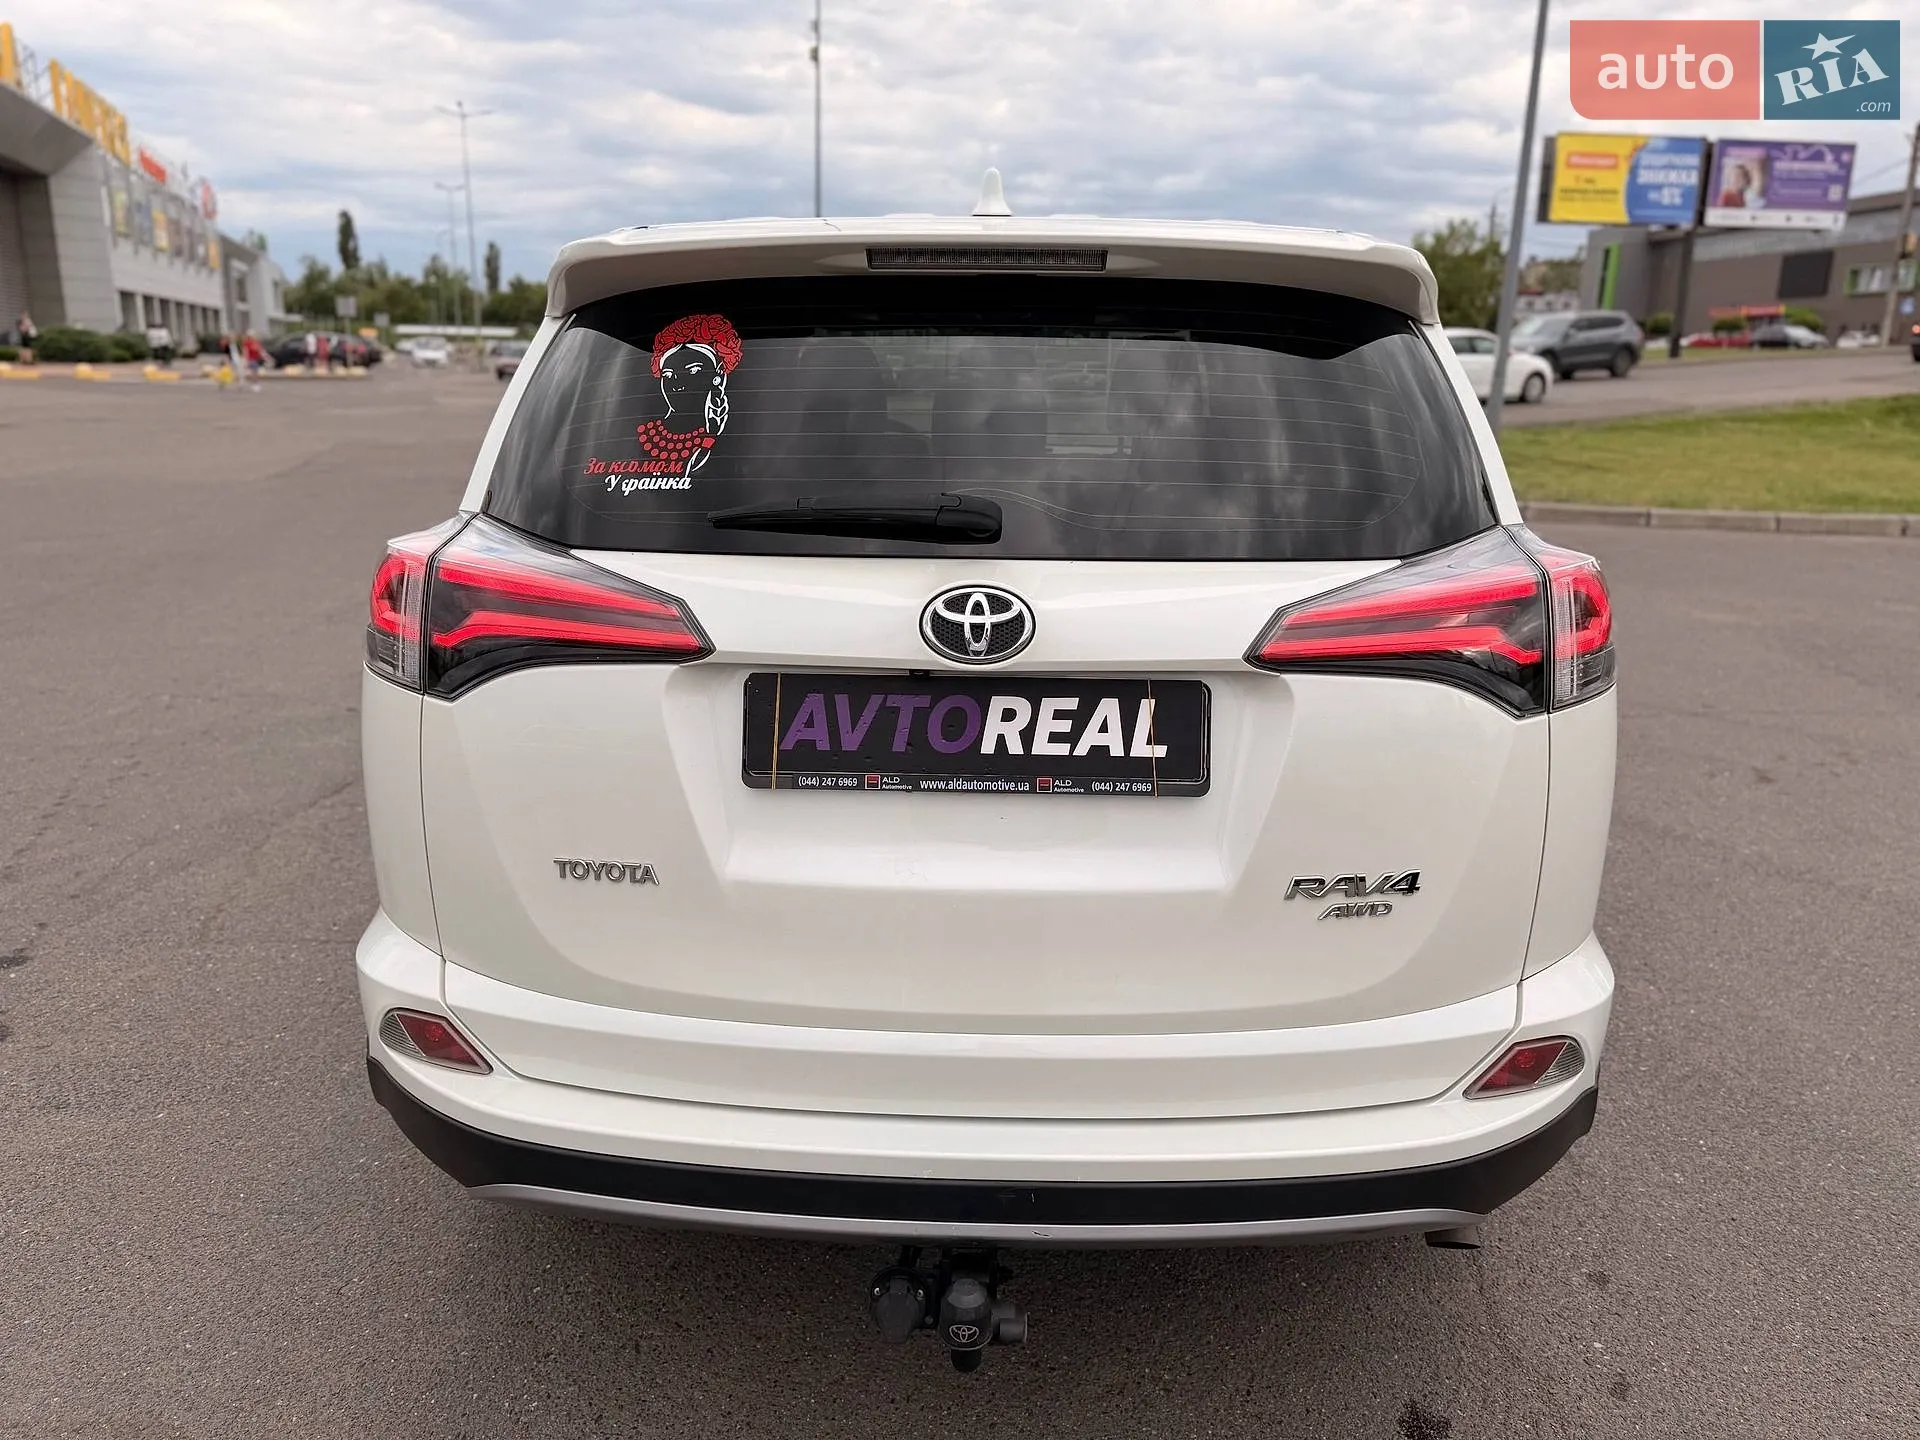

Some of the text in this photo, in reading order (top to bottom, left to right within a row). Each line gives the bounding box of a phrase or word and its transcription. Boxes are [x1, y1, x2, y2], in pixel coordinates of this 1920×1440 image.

[584, 457, 606, 474] За
[780, 694, 1168, 758] AVTOREAL
[798, 776, 858, 787] (044) 247 6969
[920, 778, 1030, 791] www.aldautomotive.ua
[1091, 781, 1152, 792] (044) 247 6969
[553, 857, 660, 886] TOYOTA
[1283, 868, 1422, 900] RAV4
[1317, 901, 1393, 921] AWD
